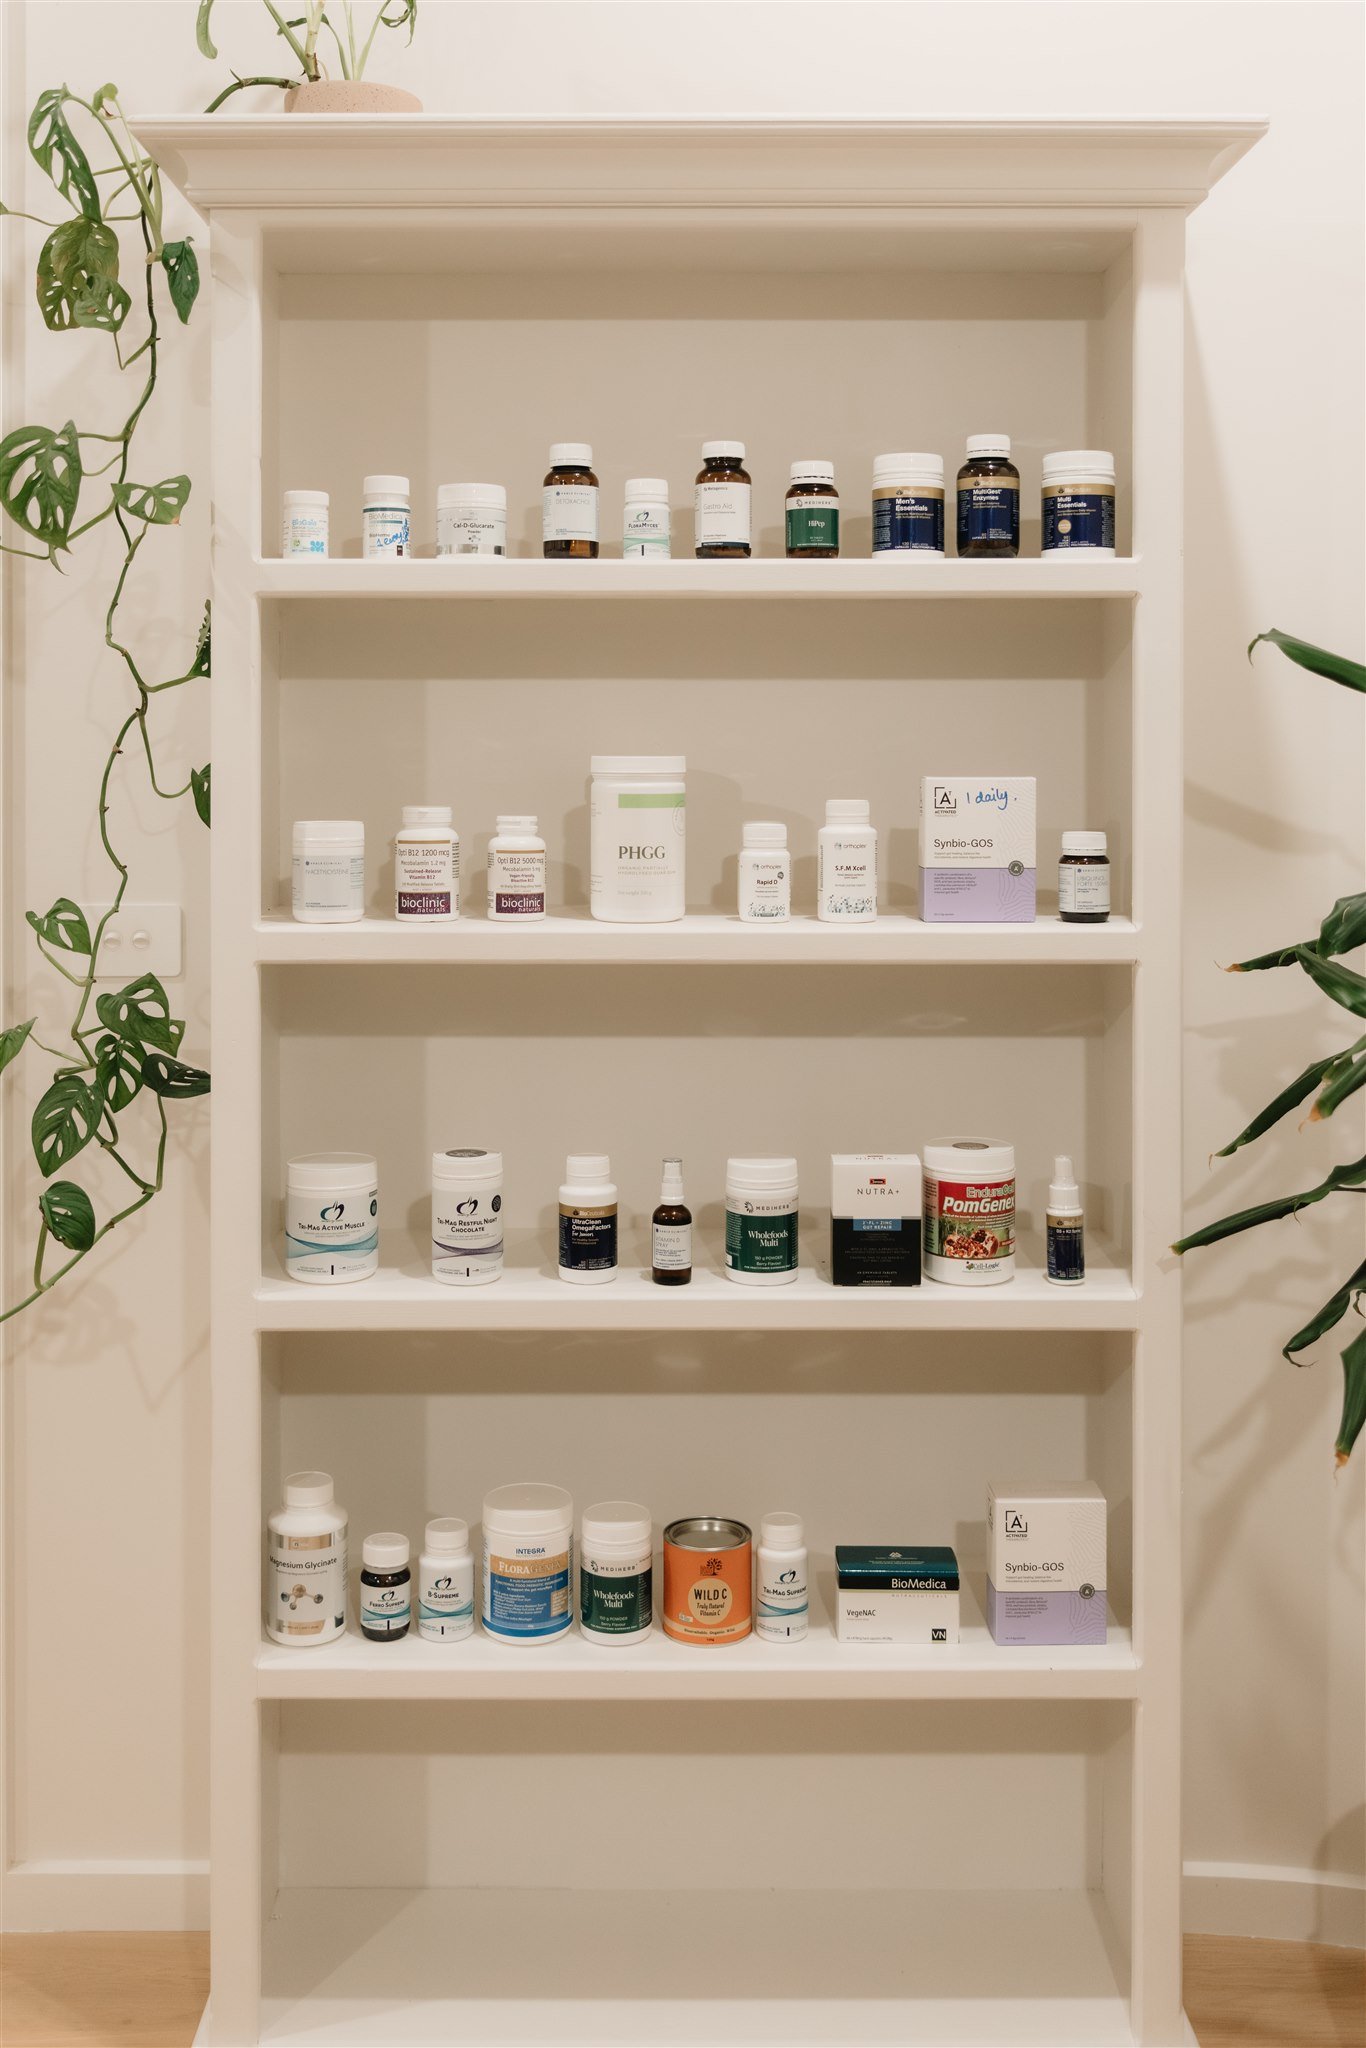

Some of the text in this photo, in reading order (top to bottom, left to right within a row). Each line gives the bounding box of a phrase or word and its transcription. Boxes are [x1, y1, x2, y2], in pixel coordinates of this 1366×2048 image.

[934, 839, 993, 850] Synbio-GOS
[619, 846, 665, 859] PHGG
[401, 897, 445, 908] bioclinic
[501, 897, 541, 907] bioclinic
[748, 1230, 789, 1239] Wholefoods
[760, 1239, 778, 1247] Multi
[304, 1558, 337, 1570] Glycinate
[1005, 1562, 1064, 1573] Synbio-GOS
[891, 1578, 946, 1590] BioMedica
[593, 1589, 634, 1599] Wholefoods
[694, 1588, 728, 1600] WILD C
[604, 1600, 623, 1608] Multi
[846, 1609, 876, 1618] VegeNAC
[932, 1631, 946, 1639] VN
